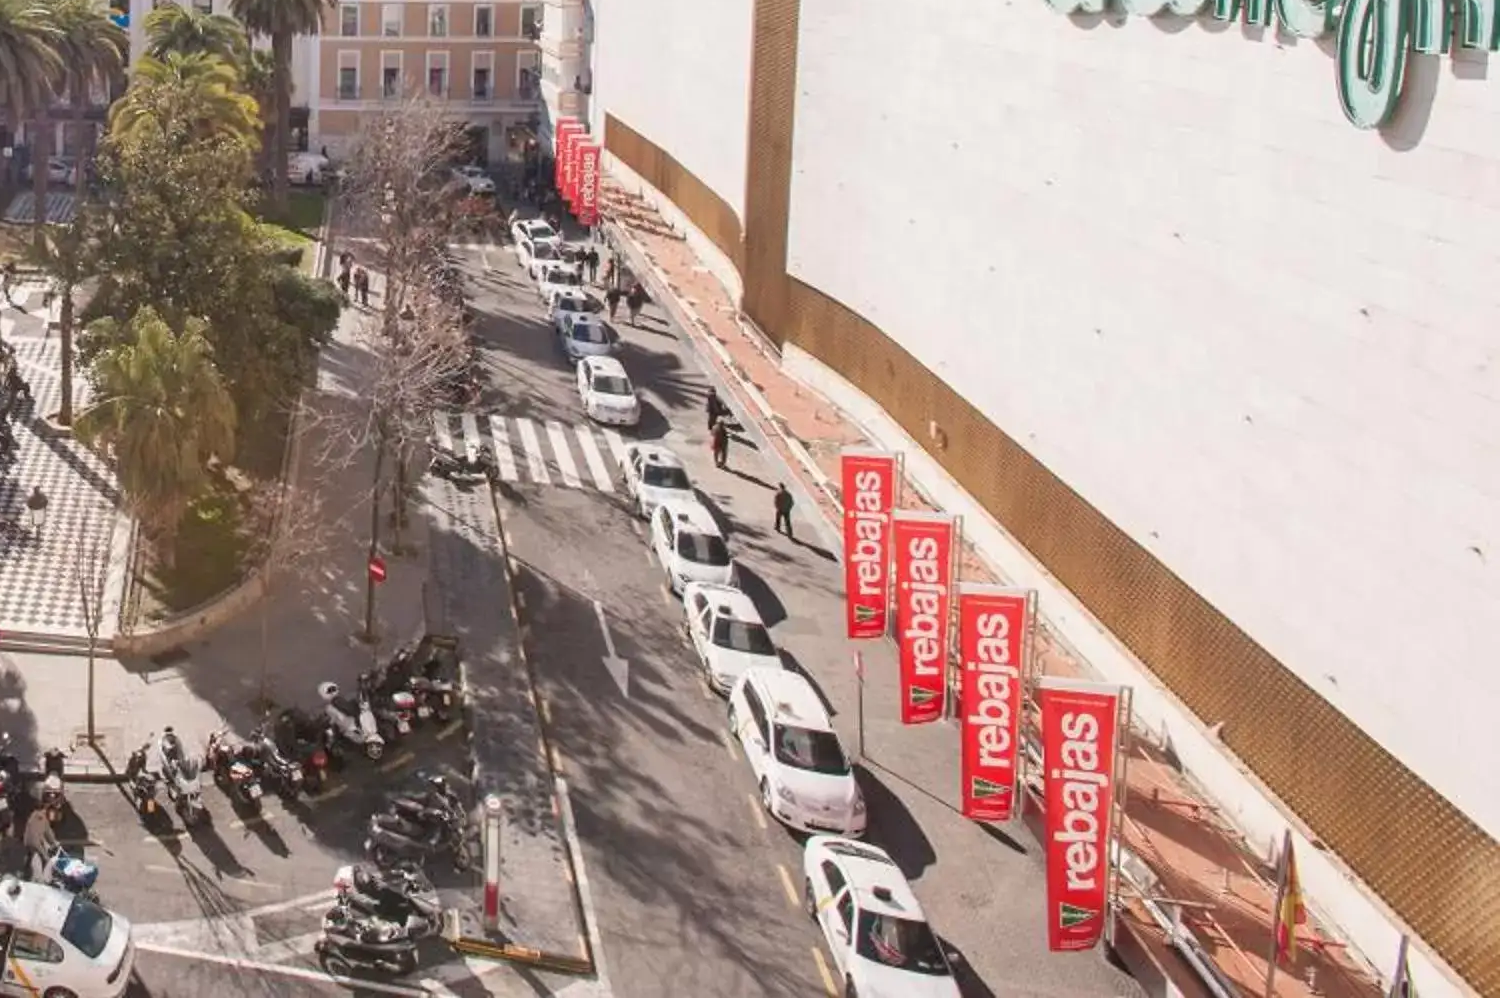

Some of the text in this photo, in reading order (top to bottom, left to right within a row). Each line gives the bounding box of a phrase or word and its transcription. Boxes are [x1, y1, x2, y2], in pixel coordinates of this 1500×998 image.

[579, 152, 600, 208] rebajas
[848, 470, 888, 596] rebajas
[901, 536, 947, 677] rebajas
[967, 613, 1020, 770] rebajas
[1050, 711, 1109, 892] rebajas
